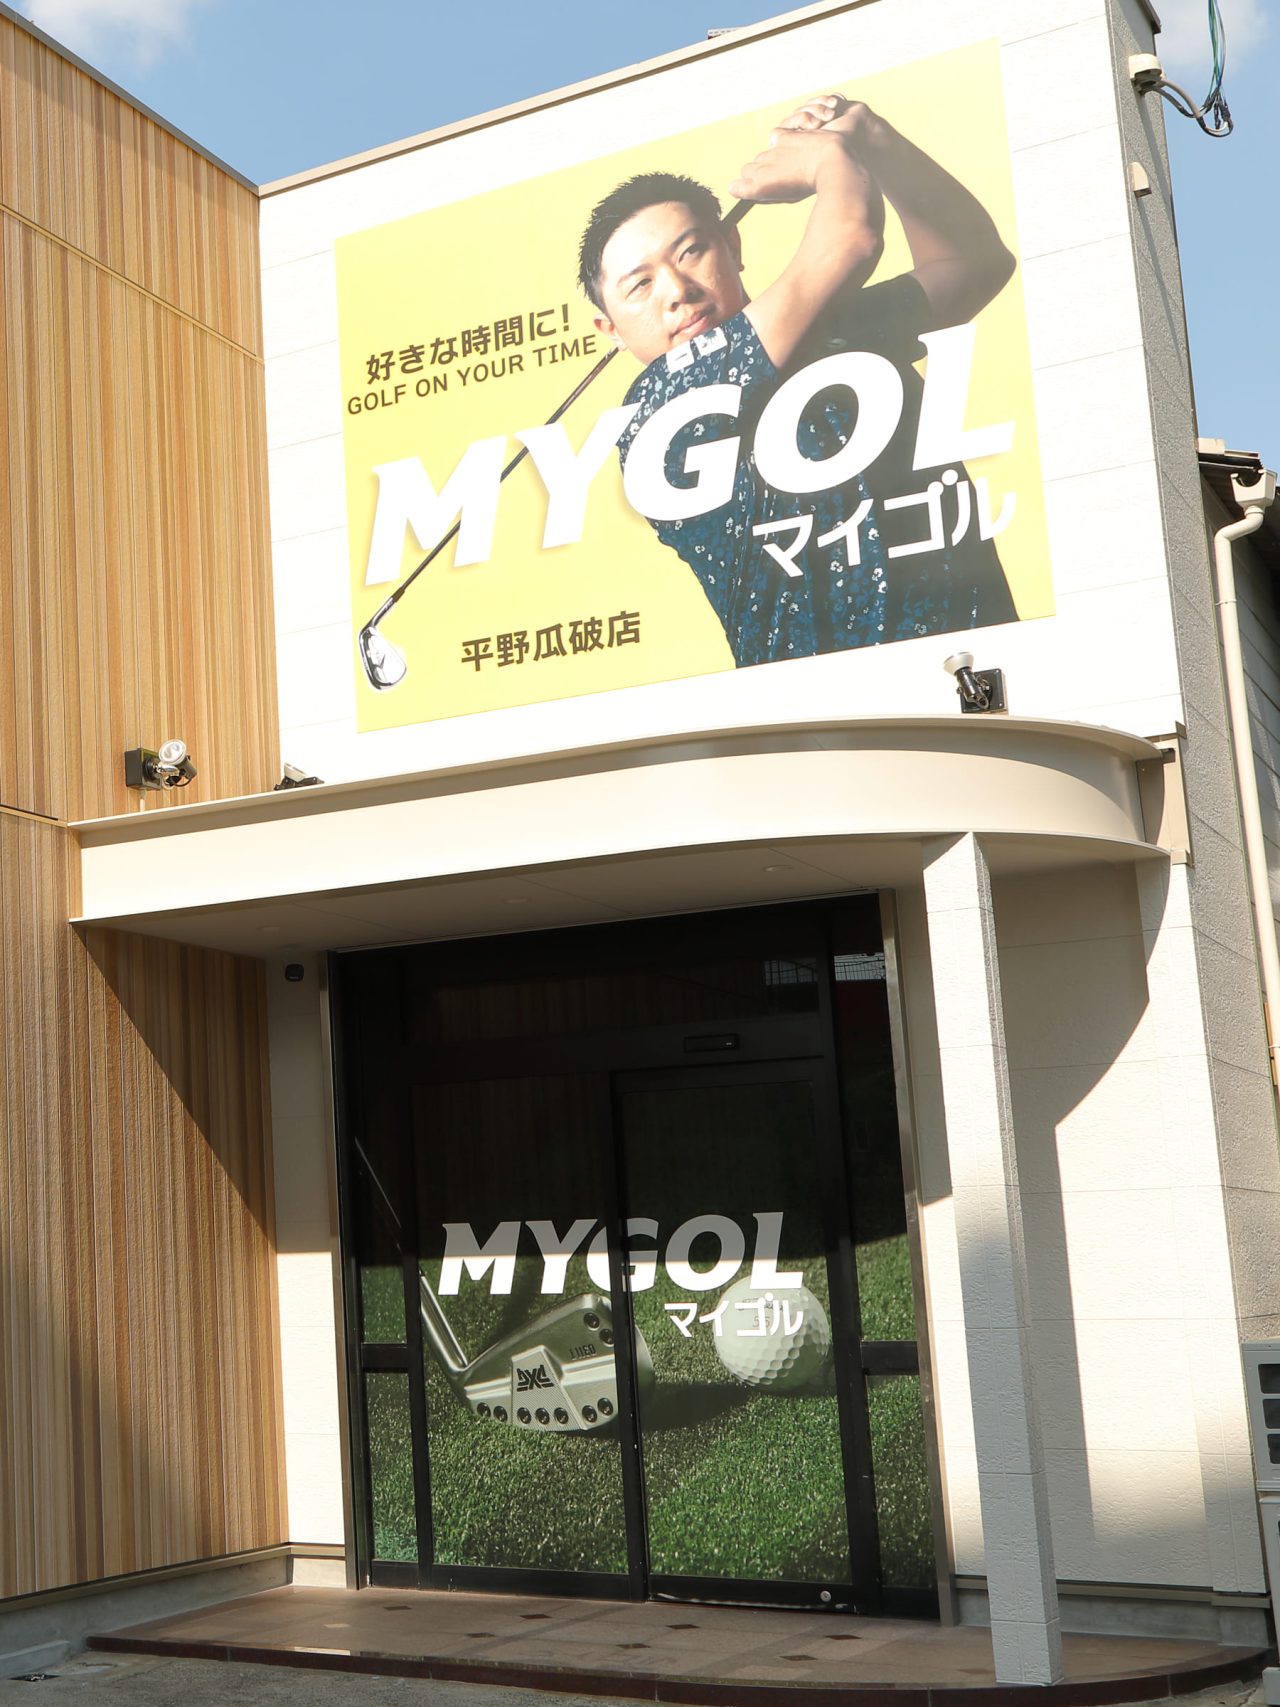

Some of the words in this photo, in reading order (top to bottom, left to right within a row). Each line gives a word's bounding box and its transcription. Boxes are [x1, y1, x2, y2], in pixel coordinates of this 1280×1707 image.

[347, 384, 407, 415] GOLF
[415, 373, 448, 397] ON
[457, 353, 524, 387] YOUR
[533, 334, 597, 367] TIME
[364, 321, 1016, 587] MYGOL
[752, 468, 1017, 578] マイゴル
[461, 610, 641, 672] 平野瓜破店
[438, 1211, 805, 1296] MYGOL
[664, 1292, 805, 1338] マイゴル
